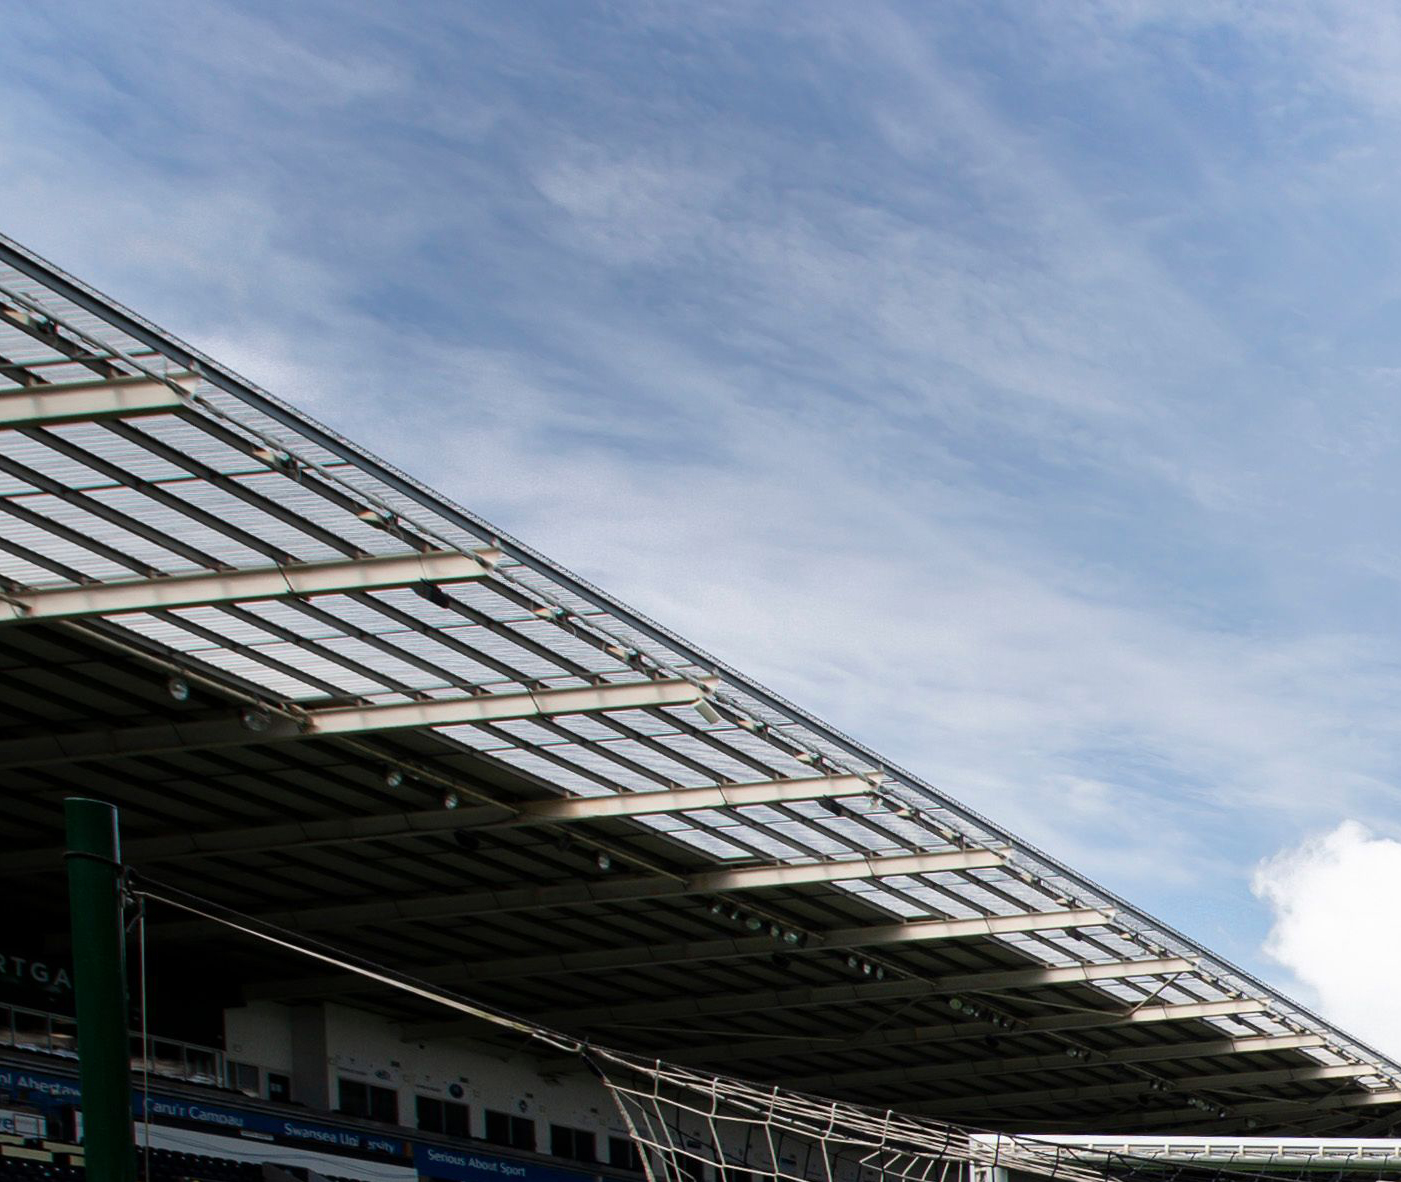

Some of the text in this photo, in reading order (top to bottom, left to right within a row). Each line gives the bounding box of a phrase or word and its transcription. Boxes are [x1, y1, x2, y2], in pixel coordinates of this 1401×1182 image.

[284, 1122, 337, 1145] Swansea
[427, 1149, 526, 1177] Serious About Sport
